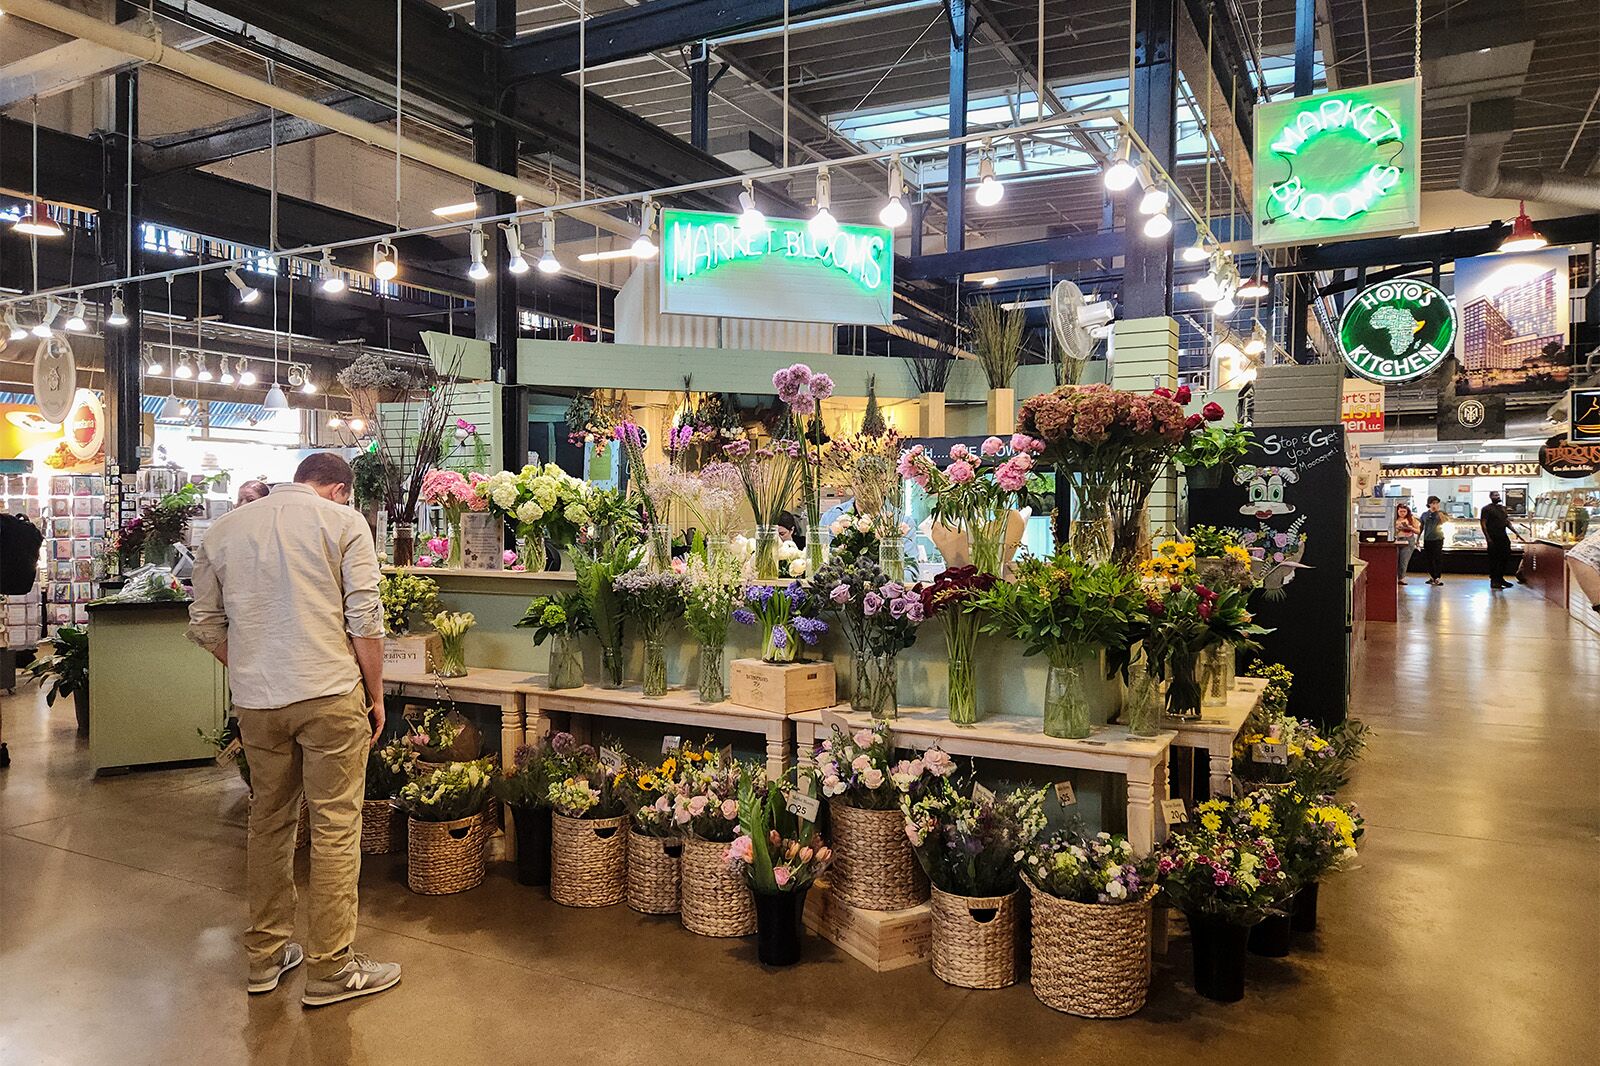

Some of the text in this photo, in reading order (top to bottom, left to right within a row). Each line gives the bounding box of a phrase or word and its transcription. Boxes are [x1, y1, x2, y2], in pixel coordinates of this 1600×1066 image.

[1271, 99, 1402, 154] MARKET
[1269, 164, 1401, 221] BLOOMS
[673, 220, 884, 289] MARKET BLOOMS
[1360, 283, 1437, 310] HOYO'S
[1348, 342, 1441, 376] KITCHEN
[1263, 434, 1299, 455] Stop
[1308, 428, 1339, 448] Get
[1388, 469, 1438, 477] MARKET
[1440, 463, 1540, 476] BUTCHERY
[1264, 745, 1275, 753] 18
[797, 804, 807, 815] 25
[346, 972, 369, 990] N
